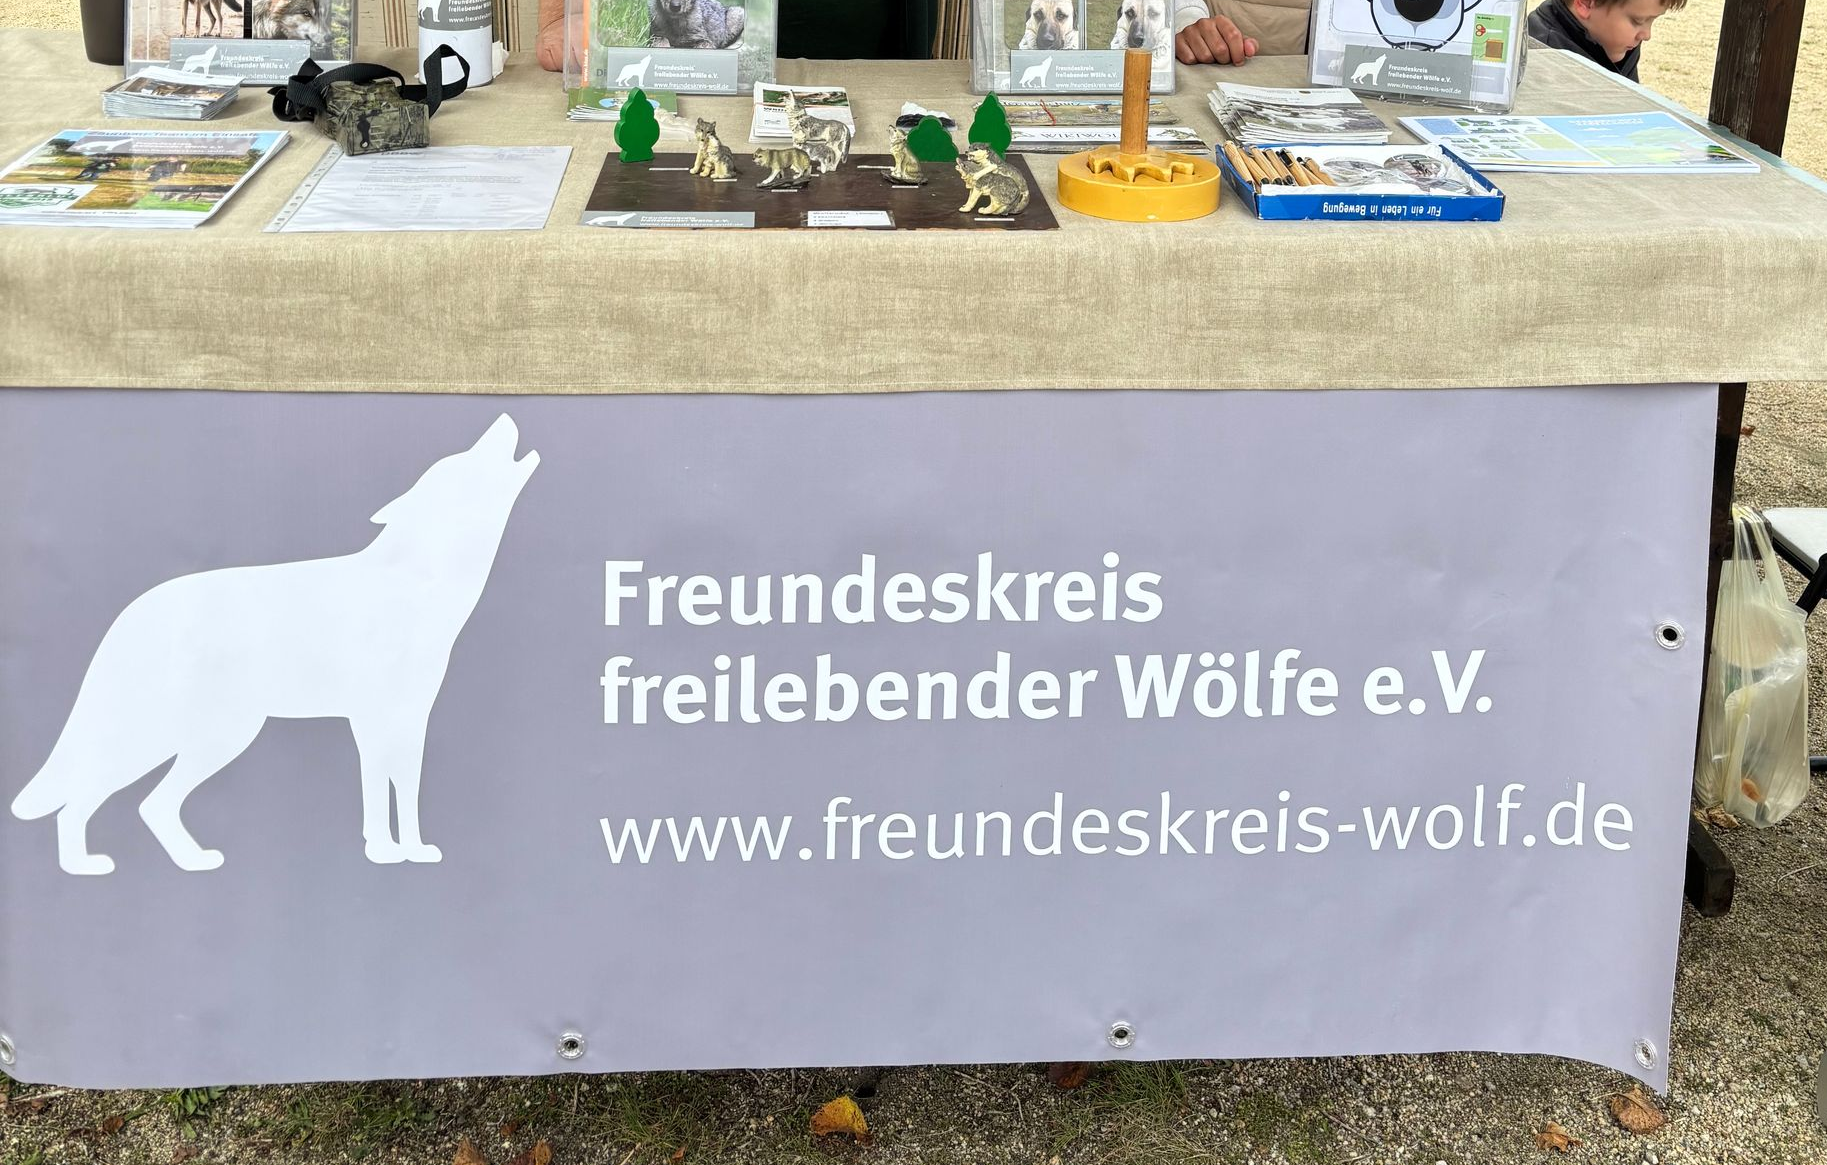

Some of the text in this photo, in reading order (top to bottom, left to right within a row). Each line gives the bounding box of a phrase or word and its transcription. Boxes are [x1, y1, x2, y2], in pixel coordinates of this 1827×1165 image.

[654, 64, 695, 72] Freundeskreis
[1388, 64, 1428, 73] Freundeskreis
[1387, 71, 1422, 80] freilebender
[1423, 74, 1440, 82] Wölfe
[1386, 82, 1462, 94] www.freundeskreis-wolf.de
[1322, 202, 1442, 217] Für ein Leben in Bewegung
[603, 550, 1163, 627] Freundeskreis
[600, 648, 1492, 725] freilebender Wölfe e.V.
[599, 781, 1635, 864] www.freundeskreis-wolf.de
